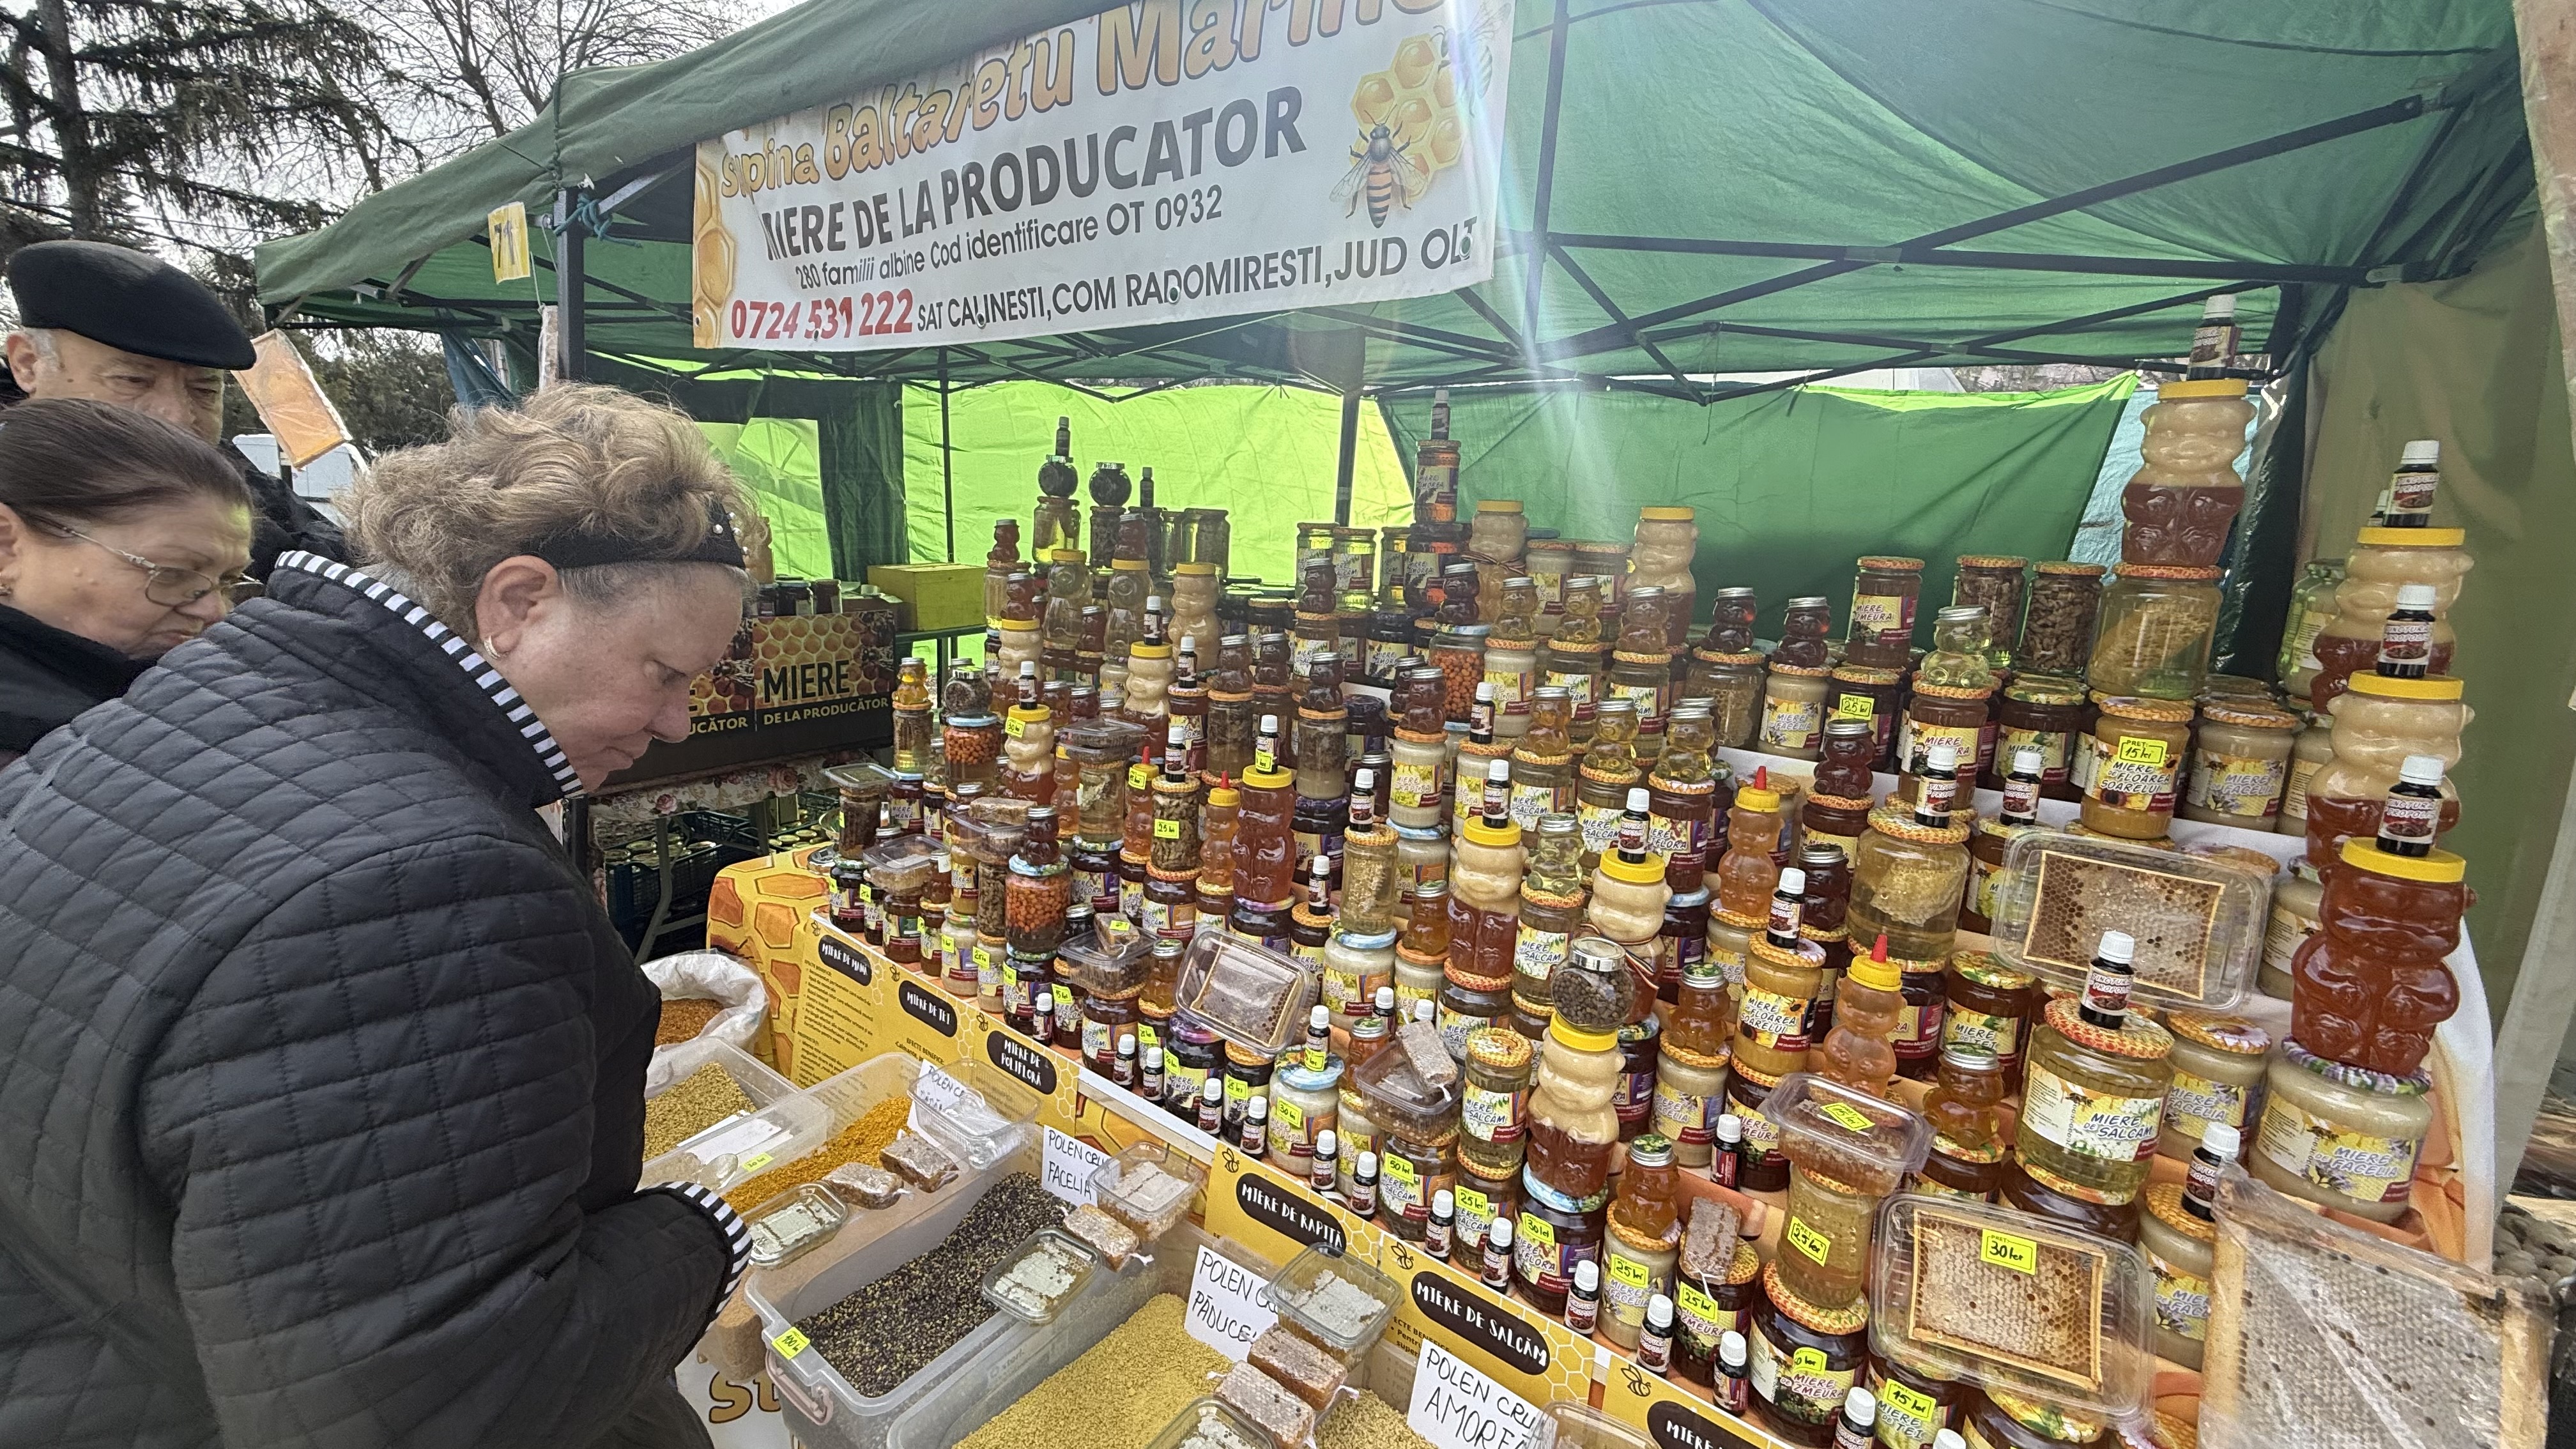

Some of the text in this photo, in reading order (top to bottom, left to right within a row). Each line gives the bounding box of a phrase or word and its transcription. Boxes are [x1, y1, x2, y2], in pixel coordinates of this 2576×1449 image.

[852, 193, 893, 249] DE
[898, 180, 937, 239] LA
[940, 86, 1307, 225] PRODUCATOR
[822, 256, 874, 287] familii
[879, 251, 925, 279] albine
[930, 236, 962, 268] Cod
[965, 215, 1098, 263] identificare
[1106, 200, 1144, 236] OT
[1155, 185, 1222, 231] 0932
[732, 300, 801, 339] 0724
[807, 298, 852, 339] 531
[861, 289, 913, 335] 222
[917, 302, 942, 332] SAT
[1855, 603, 1883, 613] MIERE
[1855, 612, 1892, 622] ZMEURA
[763, 659, 850, 703] MIERE
[763, 696, 888, 725] DE LA PRODUCĂTOR
[1844, 701, 1857, 712] 25
[1776, 714, 1806, 723] MIERE
[1924, 736, 1961, 747] MIERE
[2125, 746, 2152, 759] 15 lei
[2113, 762, 2154, 773] MIERE
[2100, 779, 2161, 794] SOARELUI
[2117, 773, 2171, 784] FLOAREA
[2225, 774, 2269, 784] MIERE
[2221, 784, 2276, 795] FACELIA
[1514, 795, 1537, 806] MIERE
[1582, 818, 1611, 829] MIERE
[1650, 827, 1671, 838] IERE
[822, 944, 841, 960] MIERE
[843, 952, 850, 965] DE
[1521, 940, 1550, 953] MIERE
[907, 992, 951, 1025] MIERE DE TEI
[1747, 997, 1779, 1013] MIERE
[1740, 1012, 1787, 1034] SOARELUI
[1750, 1009, 1797, 1026] FLOAREA
[1446, 1023, 1472, 1036] MIERE
[1955, 1023, 1996, 1041] MIERE
[1004, 1039, 1041, 1068] MIERE DE
[1466, 1098, 1493, 1113] MIERE
[2170, 1087, 2216, 1108] MIERE
[1279, 1105, 1289, 1116] 30
[1736, 1114, 1768, 1130] MIERE
[2091, 1112, 2140, 1126] MIERE
[1741, 1127, 1779, 1140] MEURA
[1048, 1129, 1107, 1168] POLEN CRU
[2333, 1147, 2393, 1166] MIERE
[1390, 1160, 1400, 1170] 50
[2330, 1158, 2398, 1177] FACELIA
[1383, 1172, 1404, 1189] MIERE
[1242, 1184, 1278, 1213] MIERE
[1282, 1202, 1298, 1222] DE
[1460, 1193, 1483, 1209] 25 lei
[1528, 1219, 1538, 1233] 30
[1517, 1234, 1538, 1254] MIERE
[1793, 1227, 1809, 1245] 25
[1989, 1243, 2008, 1258] 30
[1200, 1252, 1254, 1301] POLEN
[1615, 1261, 1633, 1278] 25
[1610, 1279, 1642, 1297] MIERE
[1417, 1282, 1462, 1316] MIERE
[1466, 1306, 1485, 1330] DE
[1609, 1289, 1650, 1307] FACELIA
[1684, 1292, 1701, 1307] 25
[1682, 1314, 1726, 1336] ZMEURA
[1427, 1349, 1490, 1403] POLEN
[1793, 1374, 1835, 1388] MIERE
[1792, 1383, 1845, 1398] ZMEURA
[1877, 1400, 1922, 1426] MIERE
[1896, 1423, 1924, 1439] TEI
